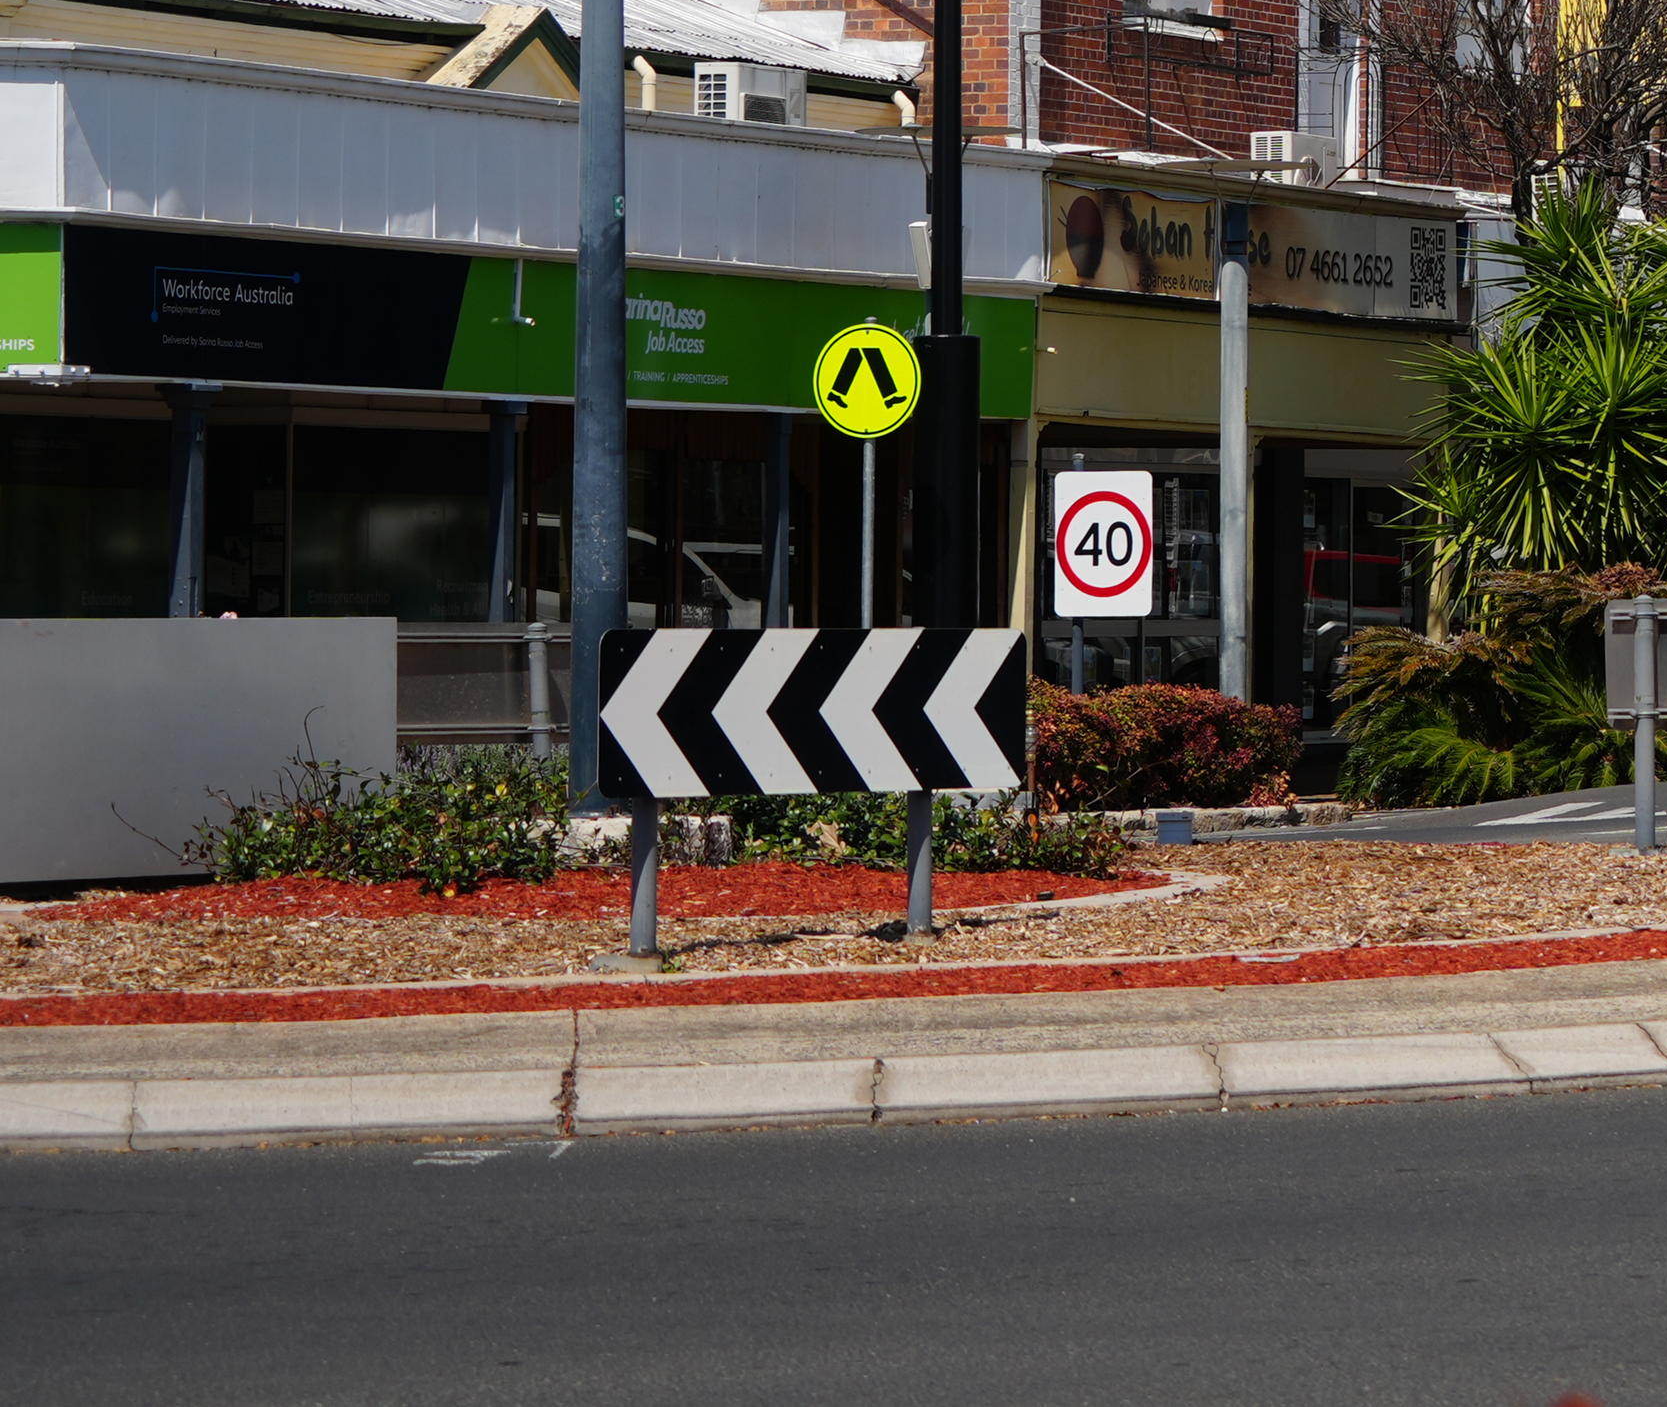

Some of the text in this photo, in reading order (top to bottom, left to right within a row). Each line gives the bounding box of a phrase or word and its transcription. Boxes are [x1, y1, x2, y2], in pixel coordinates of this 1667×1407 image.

[1120, 195, 1193, 261] Soban
[1286, 246, 1394, 287] 07 4661 2652
[163, 278, 294, 306] Workforce Australia
[1179, 274, 1187, 290] &
[1188, 275, 1213, 294] Korea
[162, 303, 221, 317] Employment Services
[163, 334, 190, 346] Delivered
[191, 336, 198, 347] by
[645, 330, 705, 354] Job Access
[633, 370, 665, 382] TRAINING
[1074, 520, 1133, 567] 40
